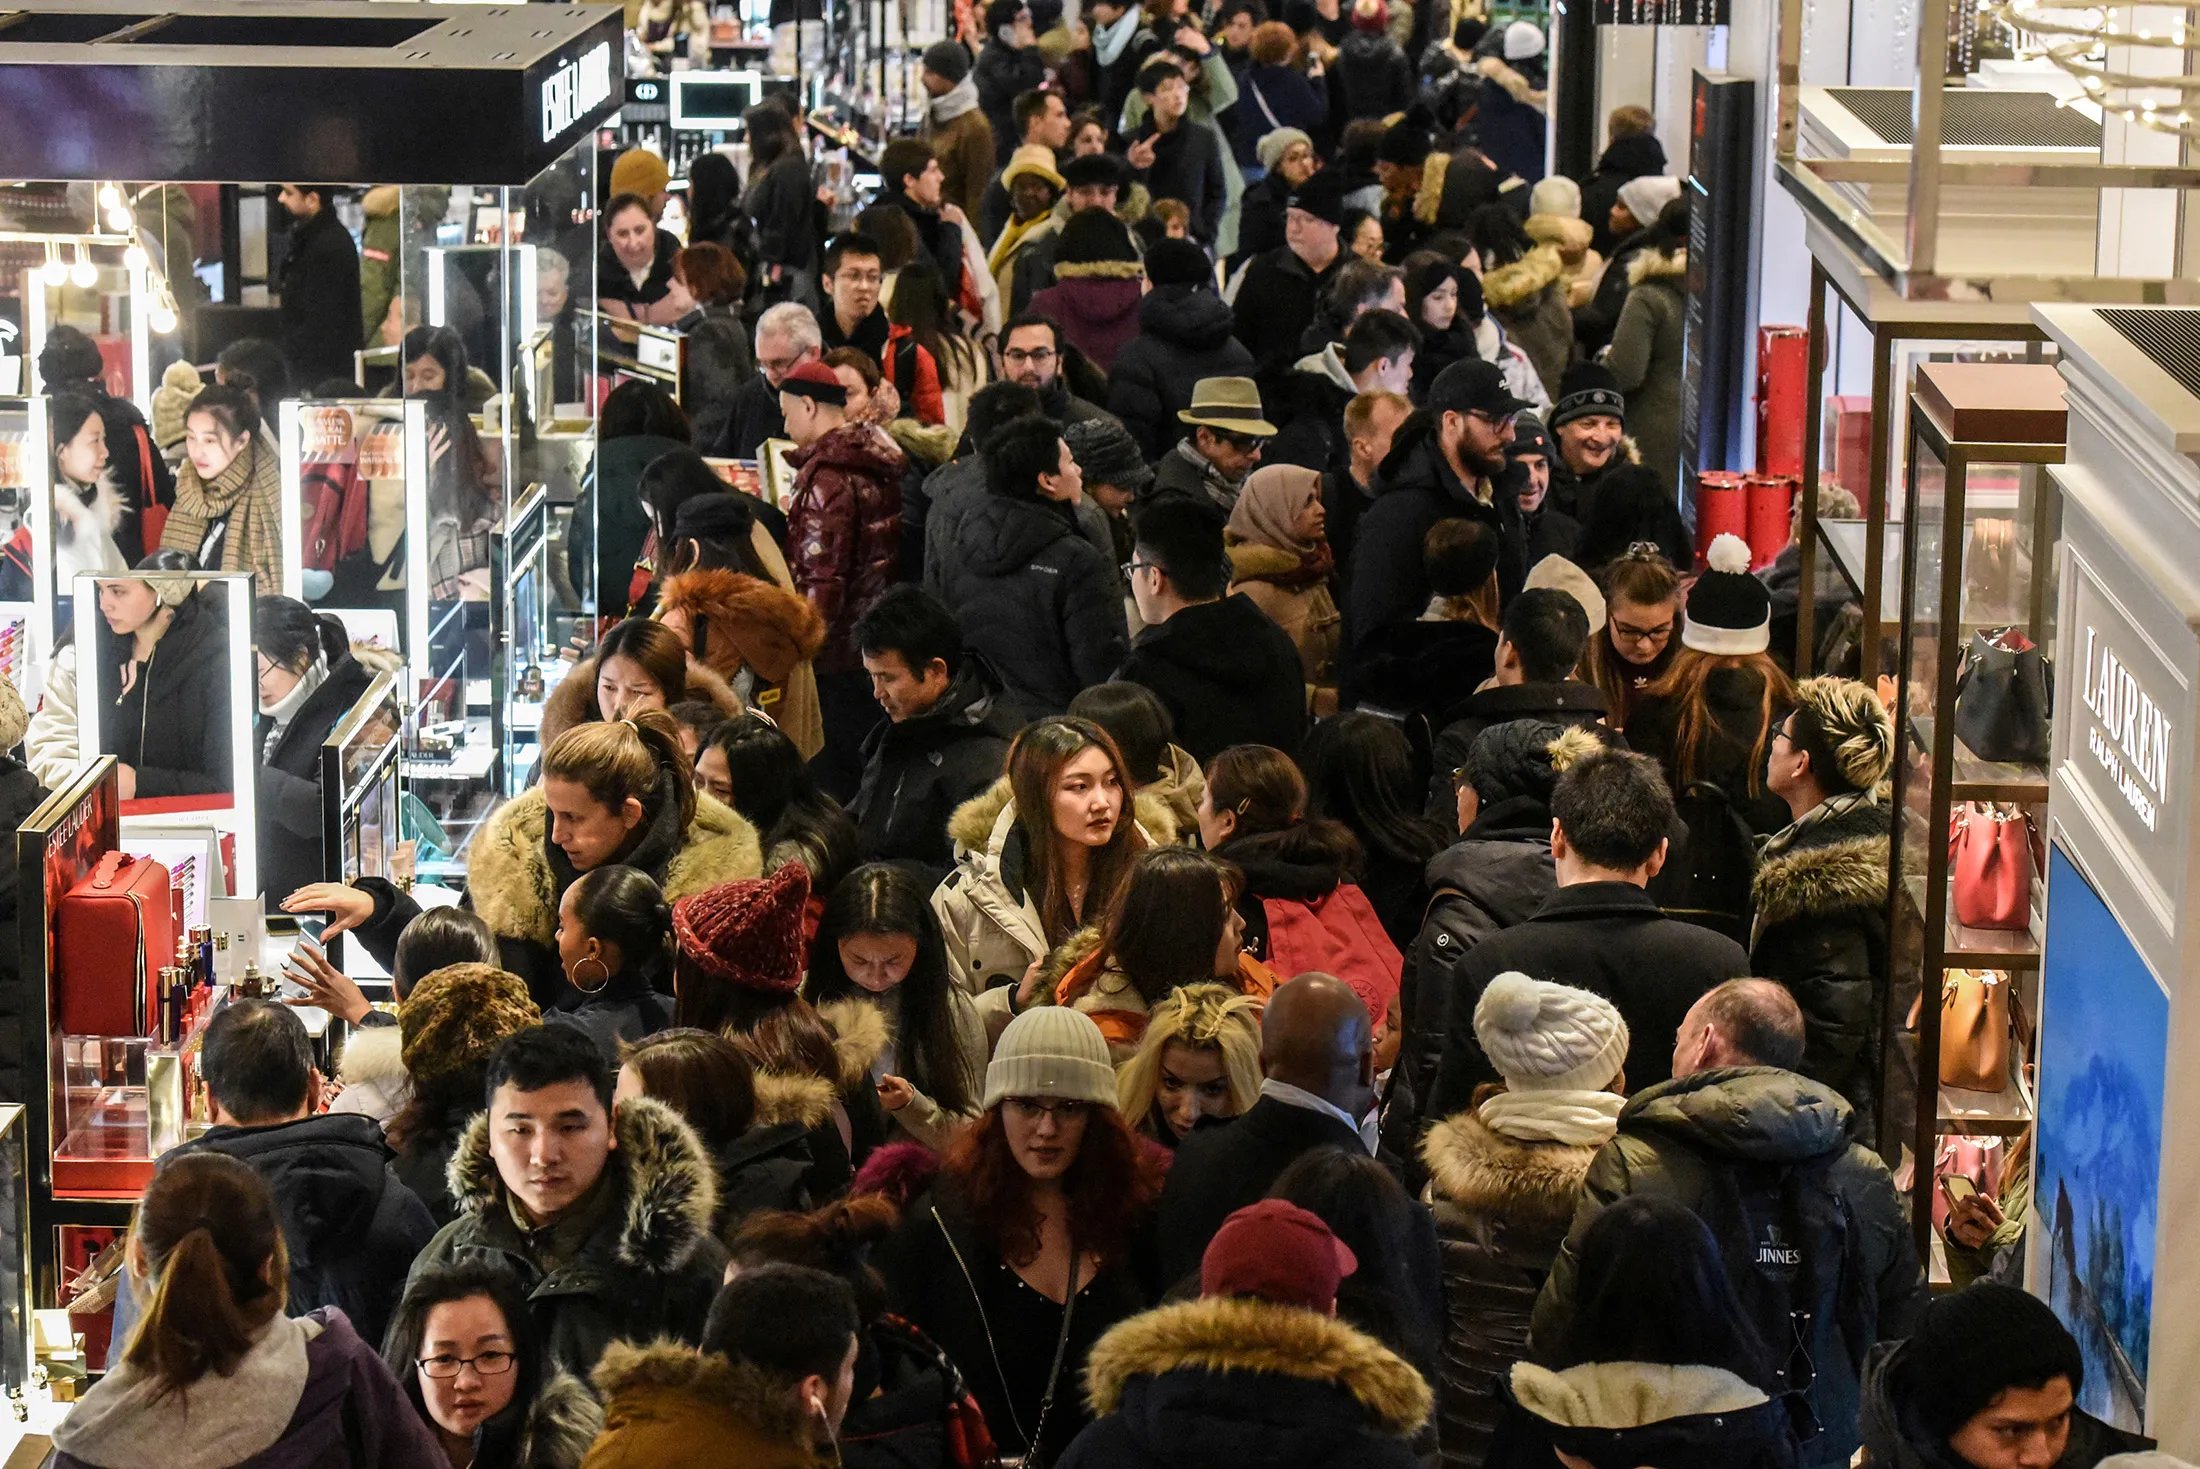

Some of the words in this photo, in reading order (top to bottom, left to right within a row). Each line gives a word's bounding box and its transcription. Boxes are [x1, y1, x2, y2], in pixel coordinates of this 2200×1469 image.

[2083, 625, 2172, 804] LAUREN
[2089, 726, 2118, 782] RALPH
[2118, 765, 2157, 832] LAUREN
